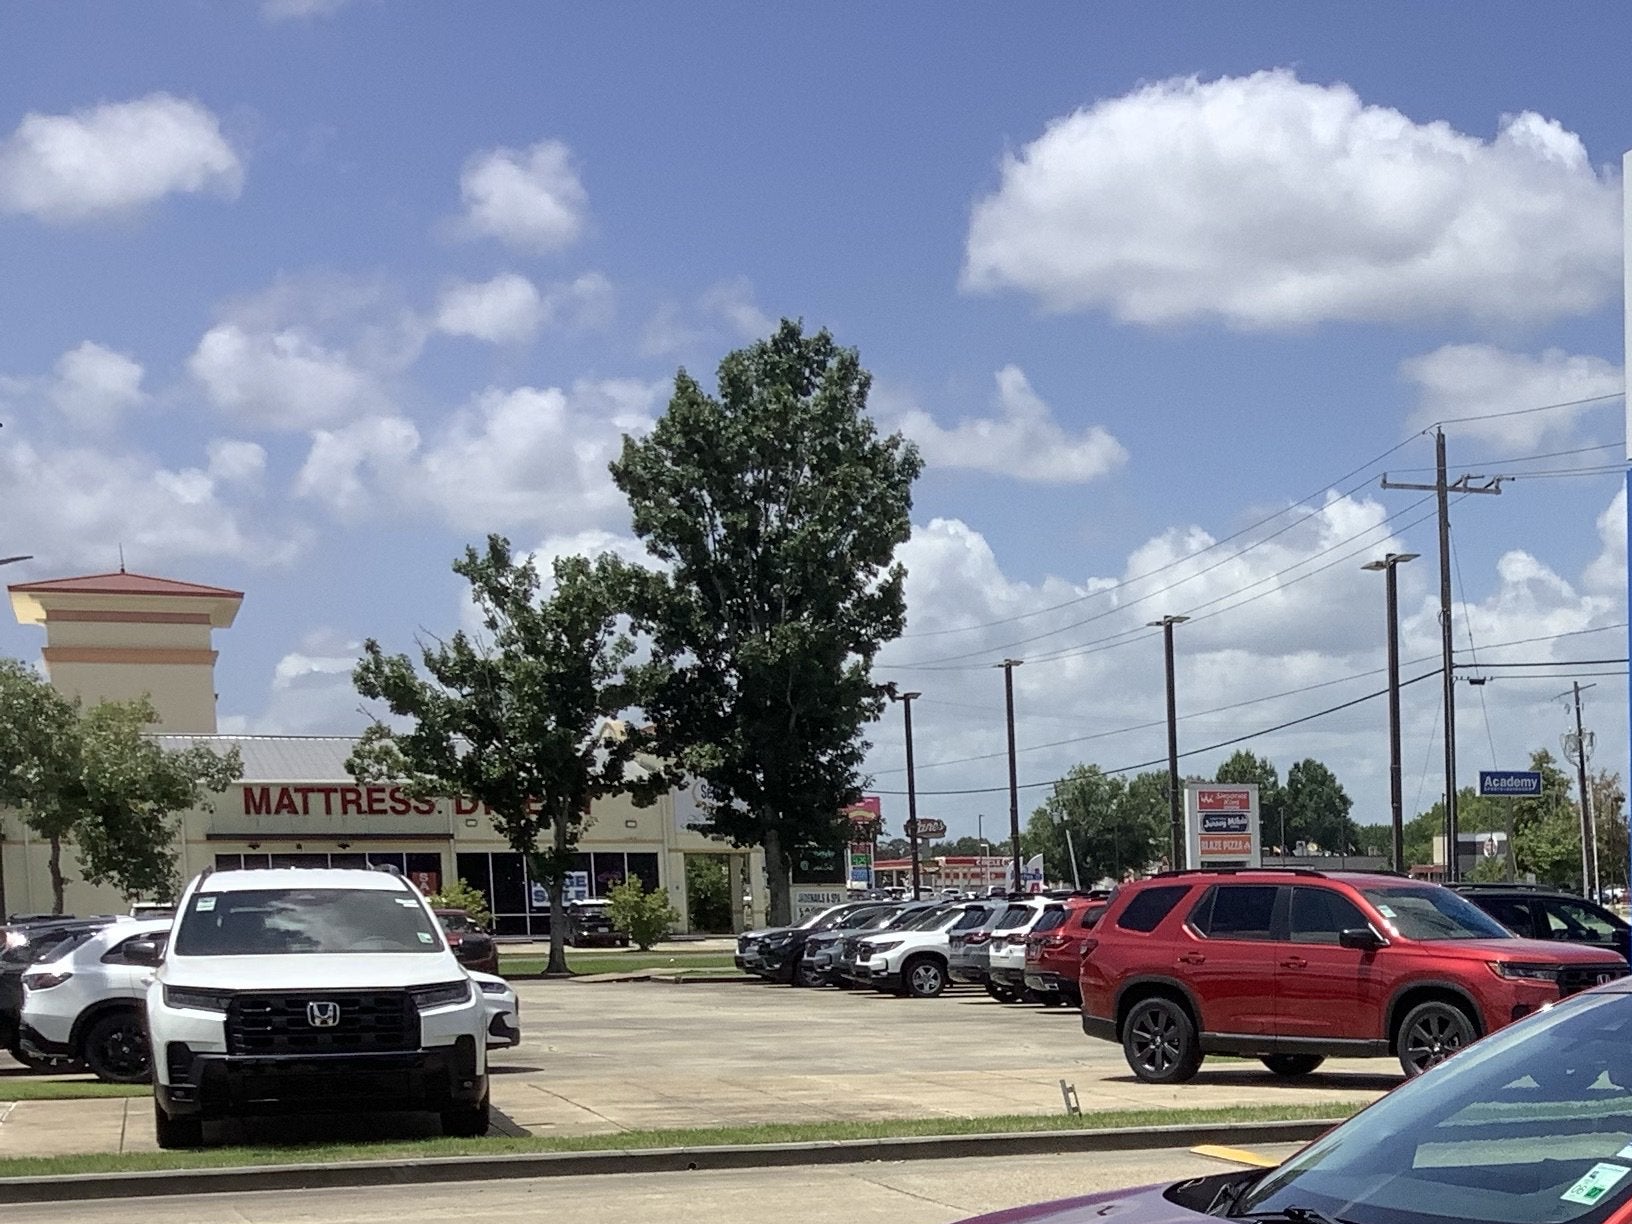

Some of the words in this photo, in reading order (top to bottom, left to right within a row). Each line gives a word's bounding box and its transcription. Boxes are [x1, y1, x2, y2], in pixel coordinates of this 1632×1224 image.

[1484, 776, 1538, 790] Academy
[243, 786, 437, 816] MATTRESS
[533, 890, 587, 902] SLE
